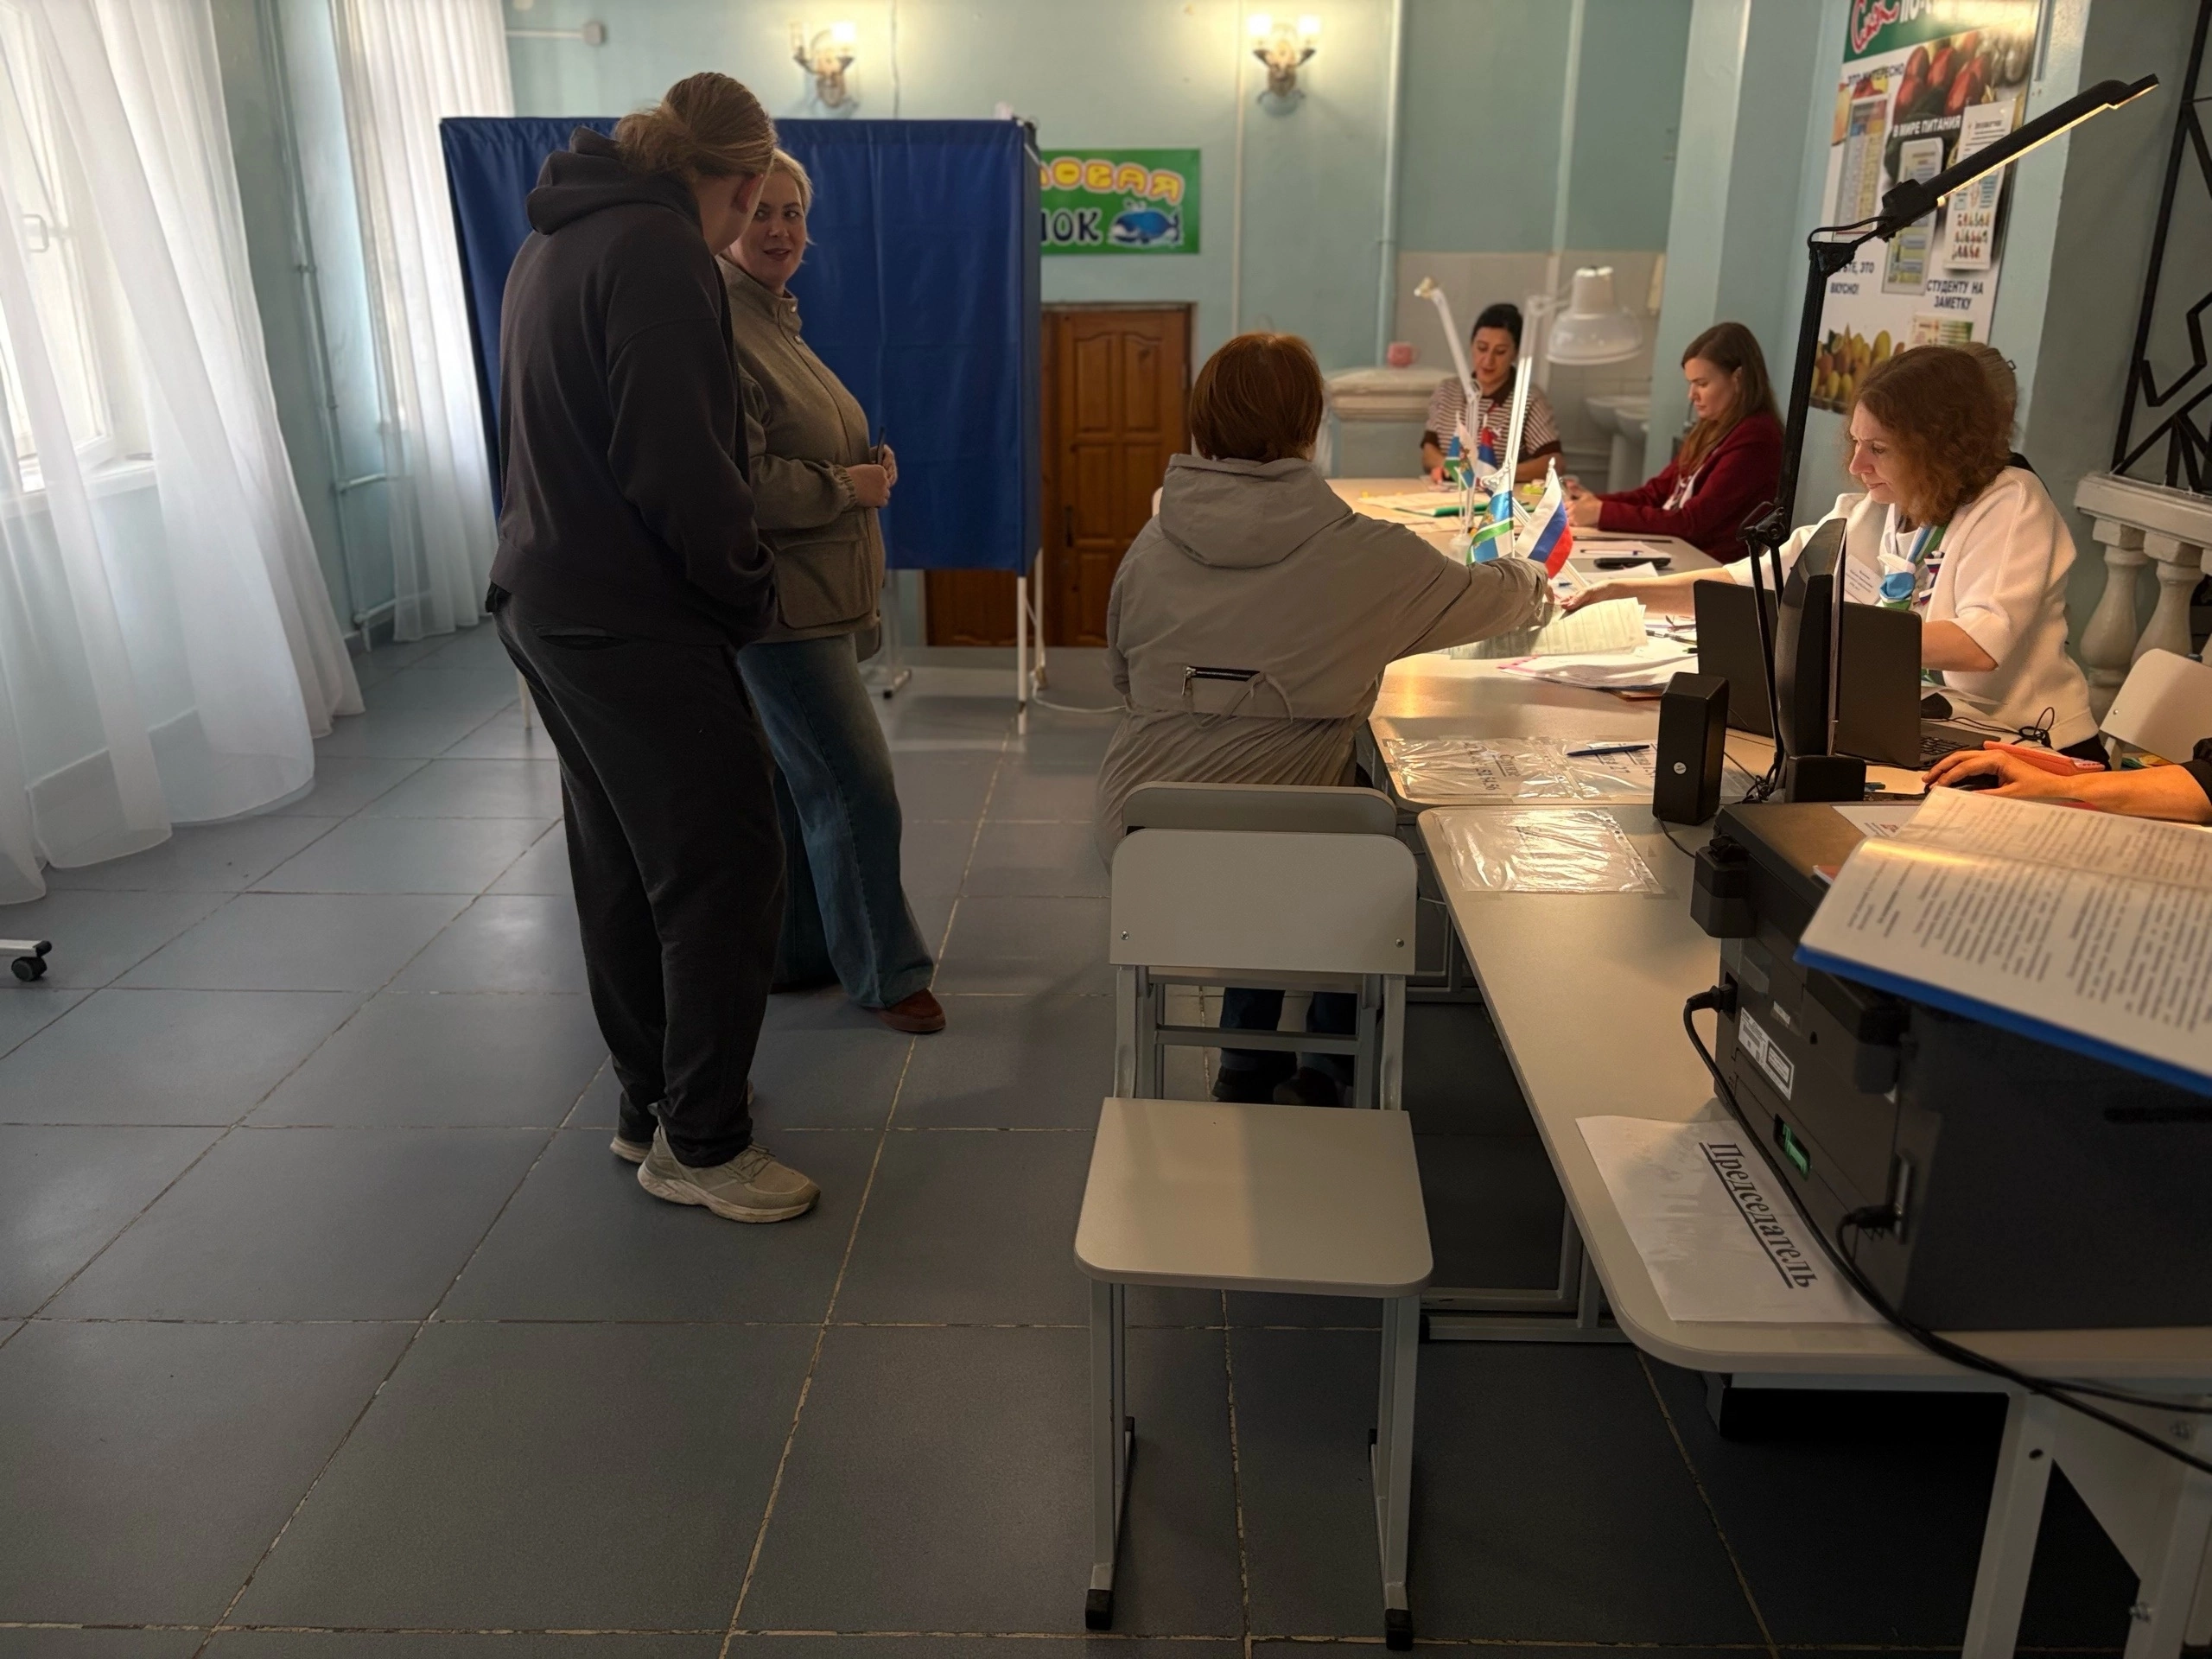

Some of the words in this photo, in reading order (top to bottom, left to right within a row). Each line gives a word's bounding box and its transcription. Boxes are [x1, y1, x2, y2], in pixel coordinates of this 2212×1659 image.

[1892, 123, 1899, 137] В
[1901, 120, 1921, 136] МИРЕ
[1922, 114, 1961, 132] ПИТАНИЯ
[1927, 279, 1968, 296] СТУДЕНТУ
[1972, 281, 1984, 296] НА
[1935, 296, 1972, 311] ЗАМЕТКУ
[1707, 1141, 1818, 1288] Председатель
